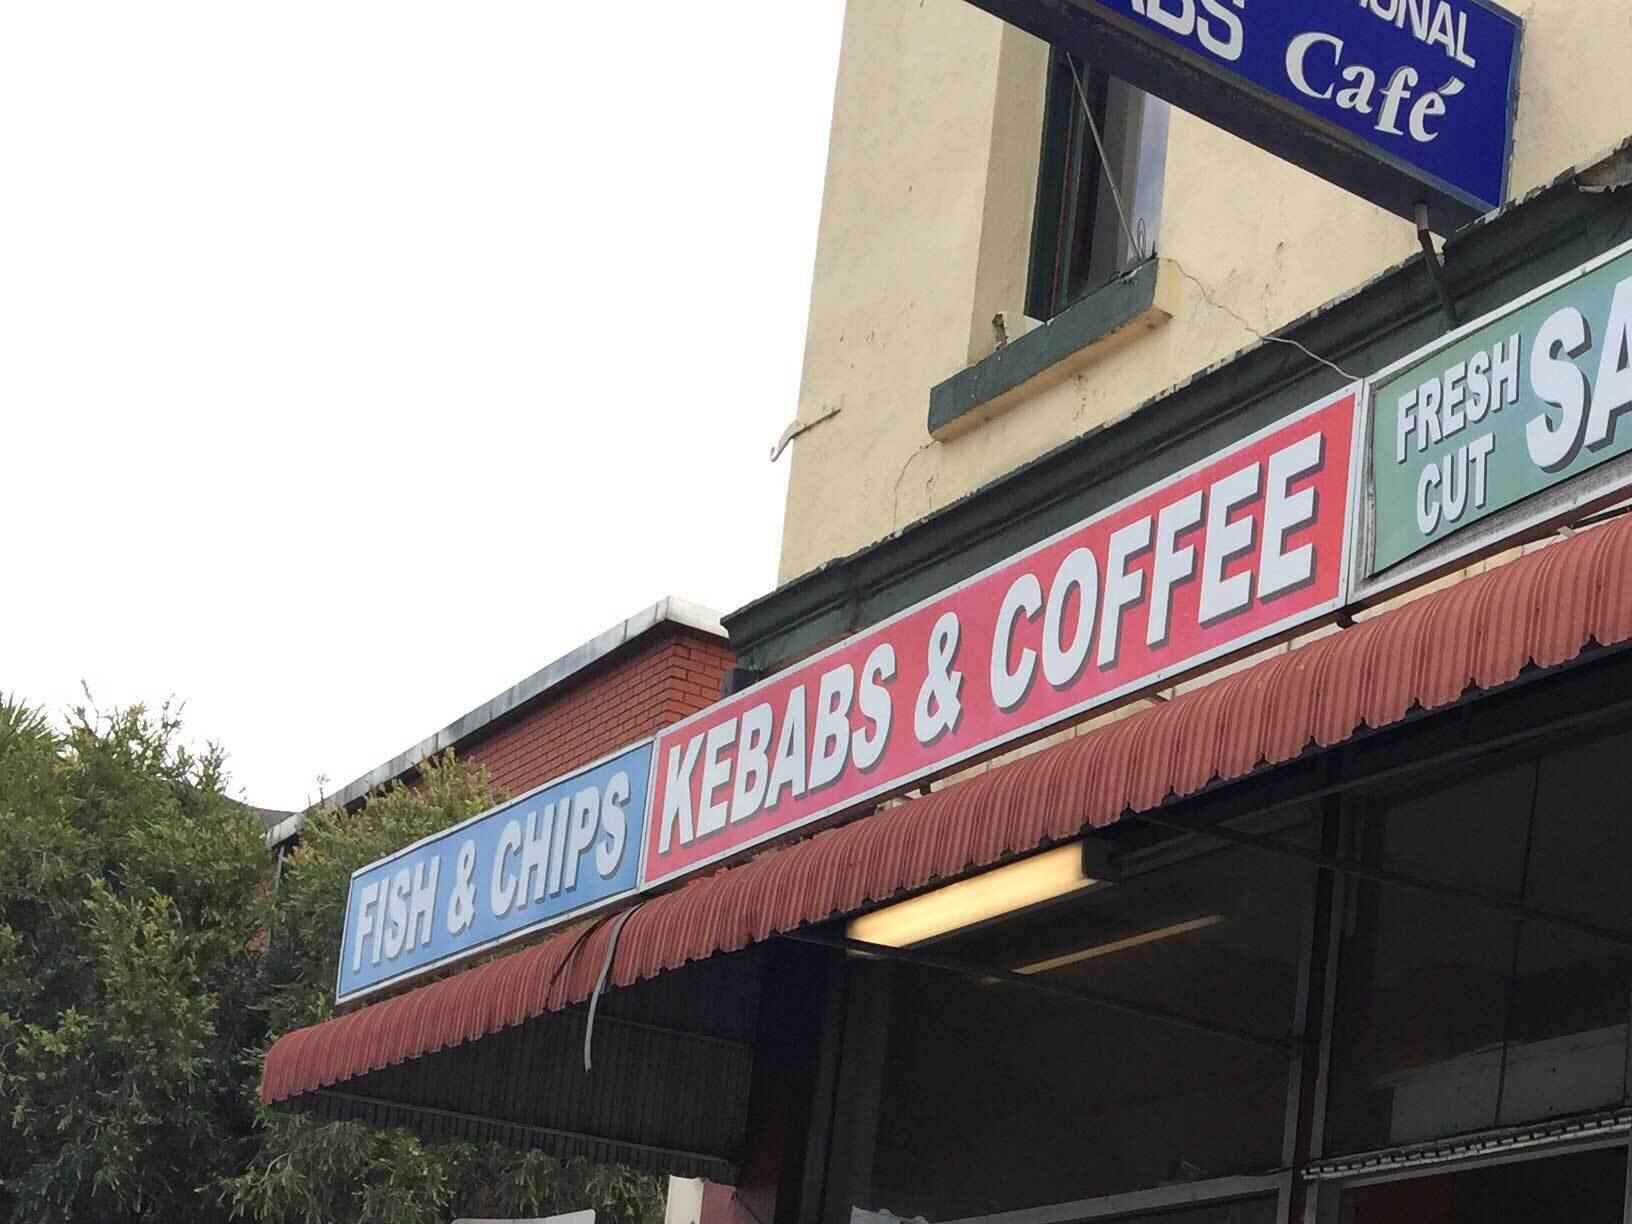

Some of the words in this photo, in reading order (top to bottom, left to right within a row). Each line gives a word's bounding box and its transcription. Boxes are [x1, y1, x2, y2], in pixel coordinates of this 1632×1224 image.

[1131, 0, 1244, 61] BS
[1358, 0, 1475, 68] ONAL
[1285, 32, 1465, 142] Café
[1397, 333, 1519, 463] FRESH
[1417, 433, 1494, 534] CUT
[658, 642, 894, 854] KEBABS
[913, 612, 960, 741] &
[990, 432, 1322, 708] COFFEE
[353, 855, 440, 972] FISH
[448, 839, 476, 934] &
[491, 771, 629, 917] CHIPS
